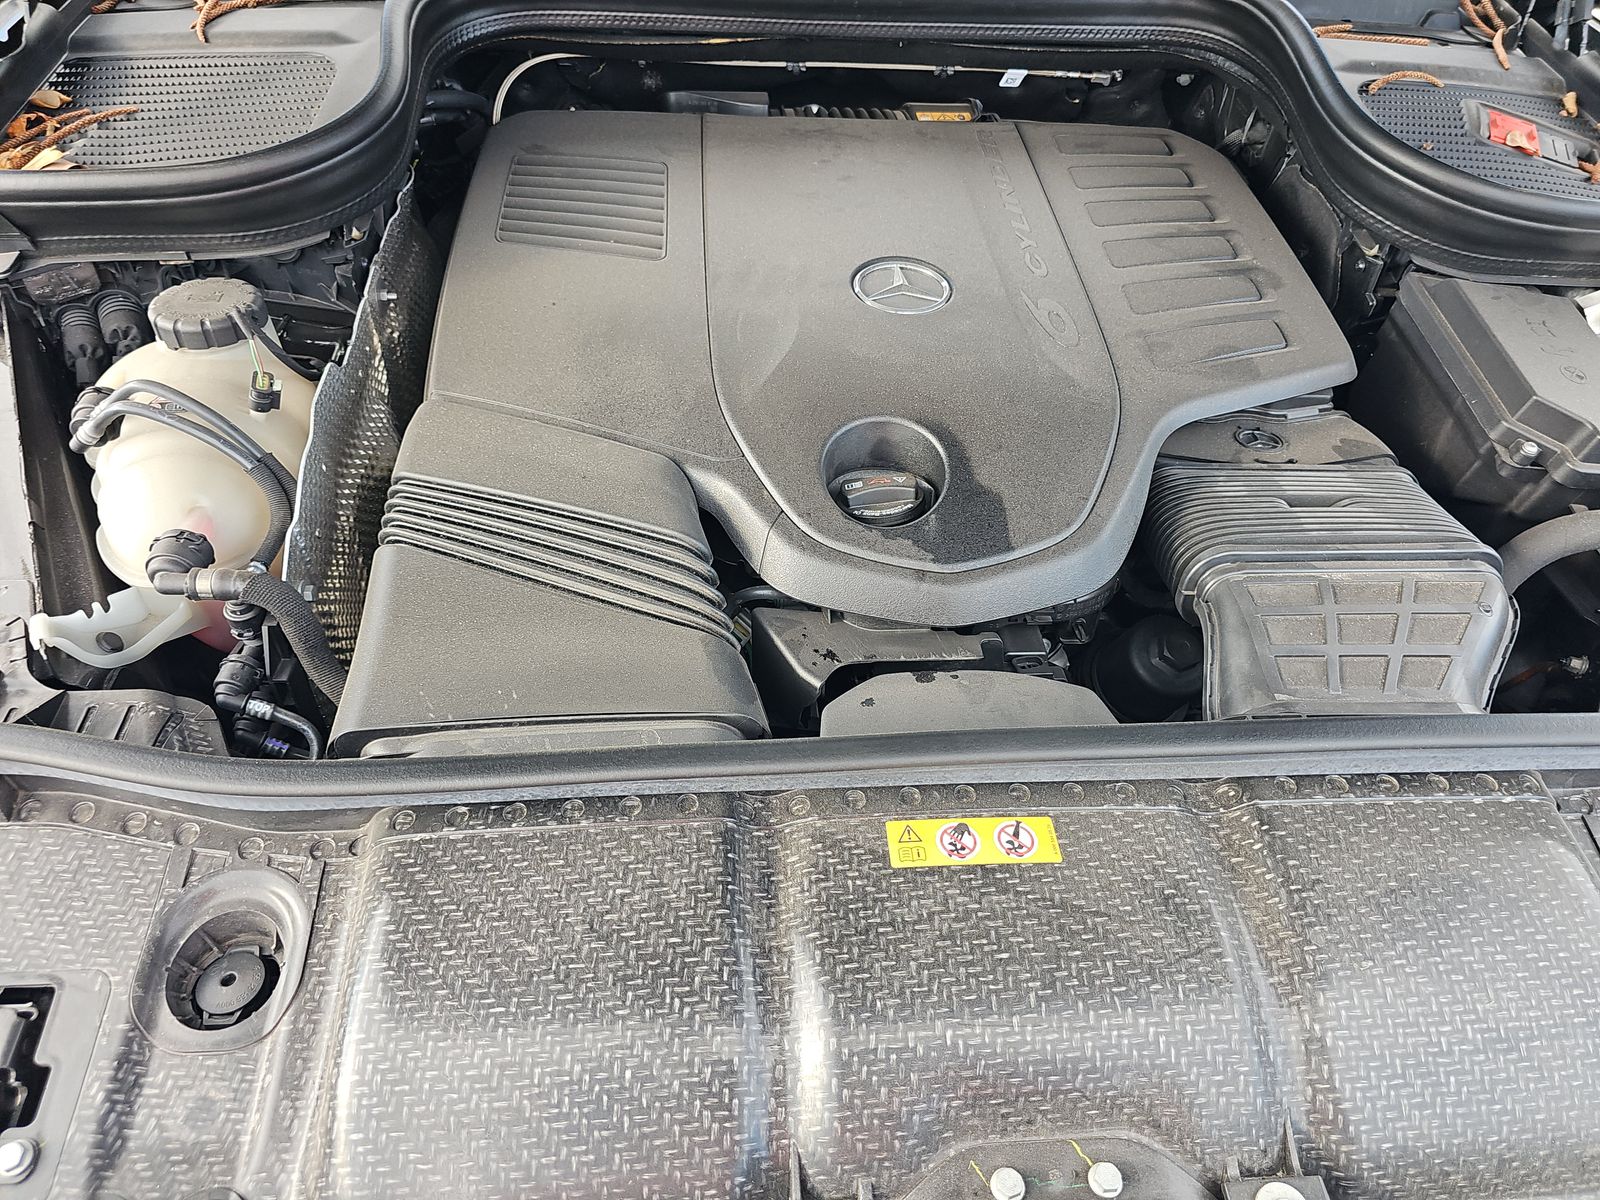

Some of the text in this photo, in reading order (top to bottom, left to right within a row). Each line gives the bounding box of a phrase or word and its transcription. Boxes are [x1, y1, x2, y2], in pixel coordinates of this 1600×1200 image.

[976, 130, 1080, 348] 6 CYLINDER
[248, 699, 271, 713] TOP
